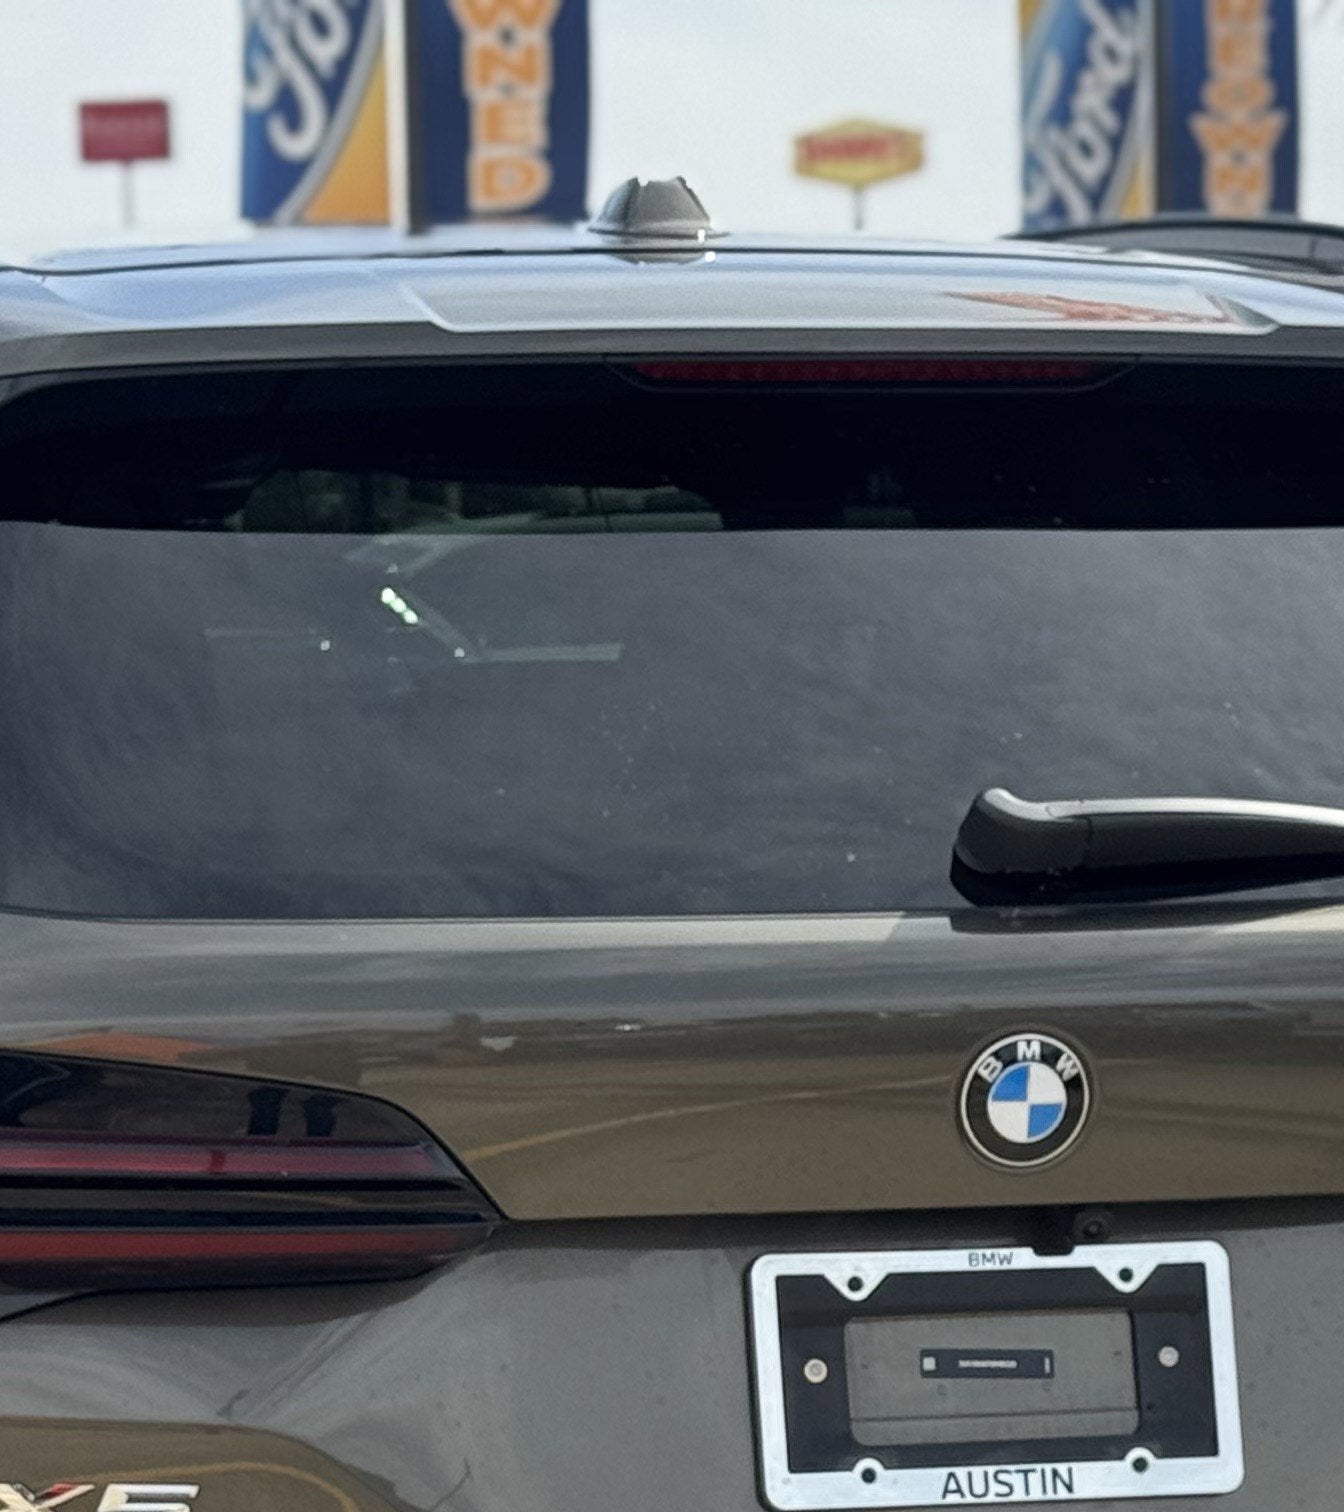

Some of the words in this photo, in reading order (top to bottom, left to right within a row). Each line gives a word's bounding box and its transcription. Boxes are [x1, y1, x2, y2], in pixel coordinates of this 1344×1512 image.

[977, 1040, 1081, 1084] BMW
[967, 1251, 1014, 1268] BMW
[941, 1466, 1075, 1501] AUSTIN
